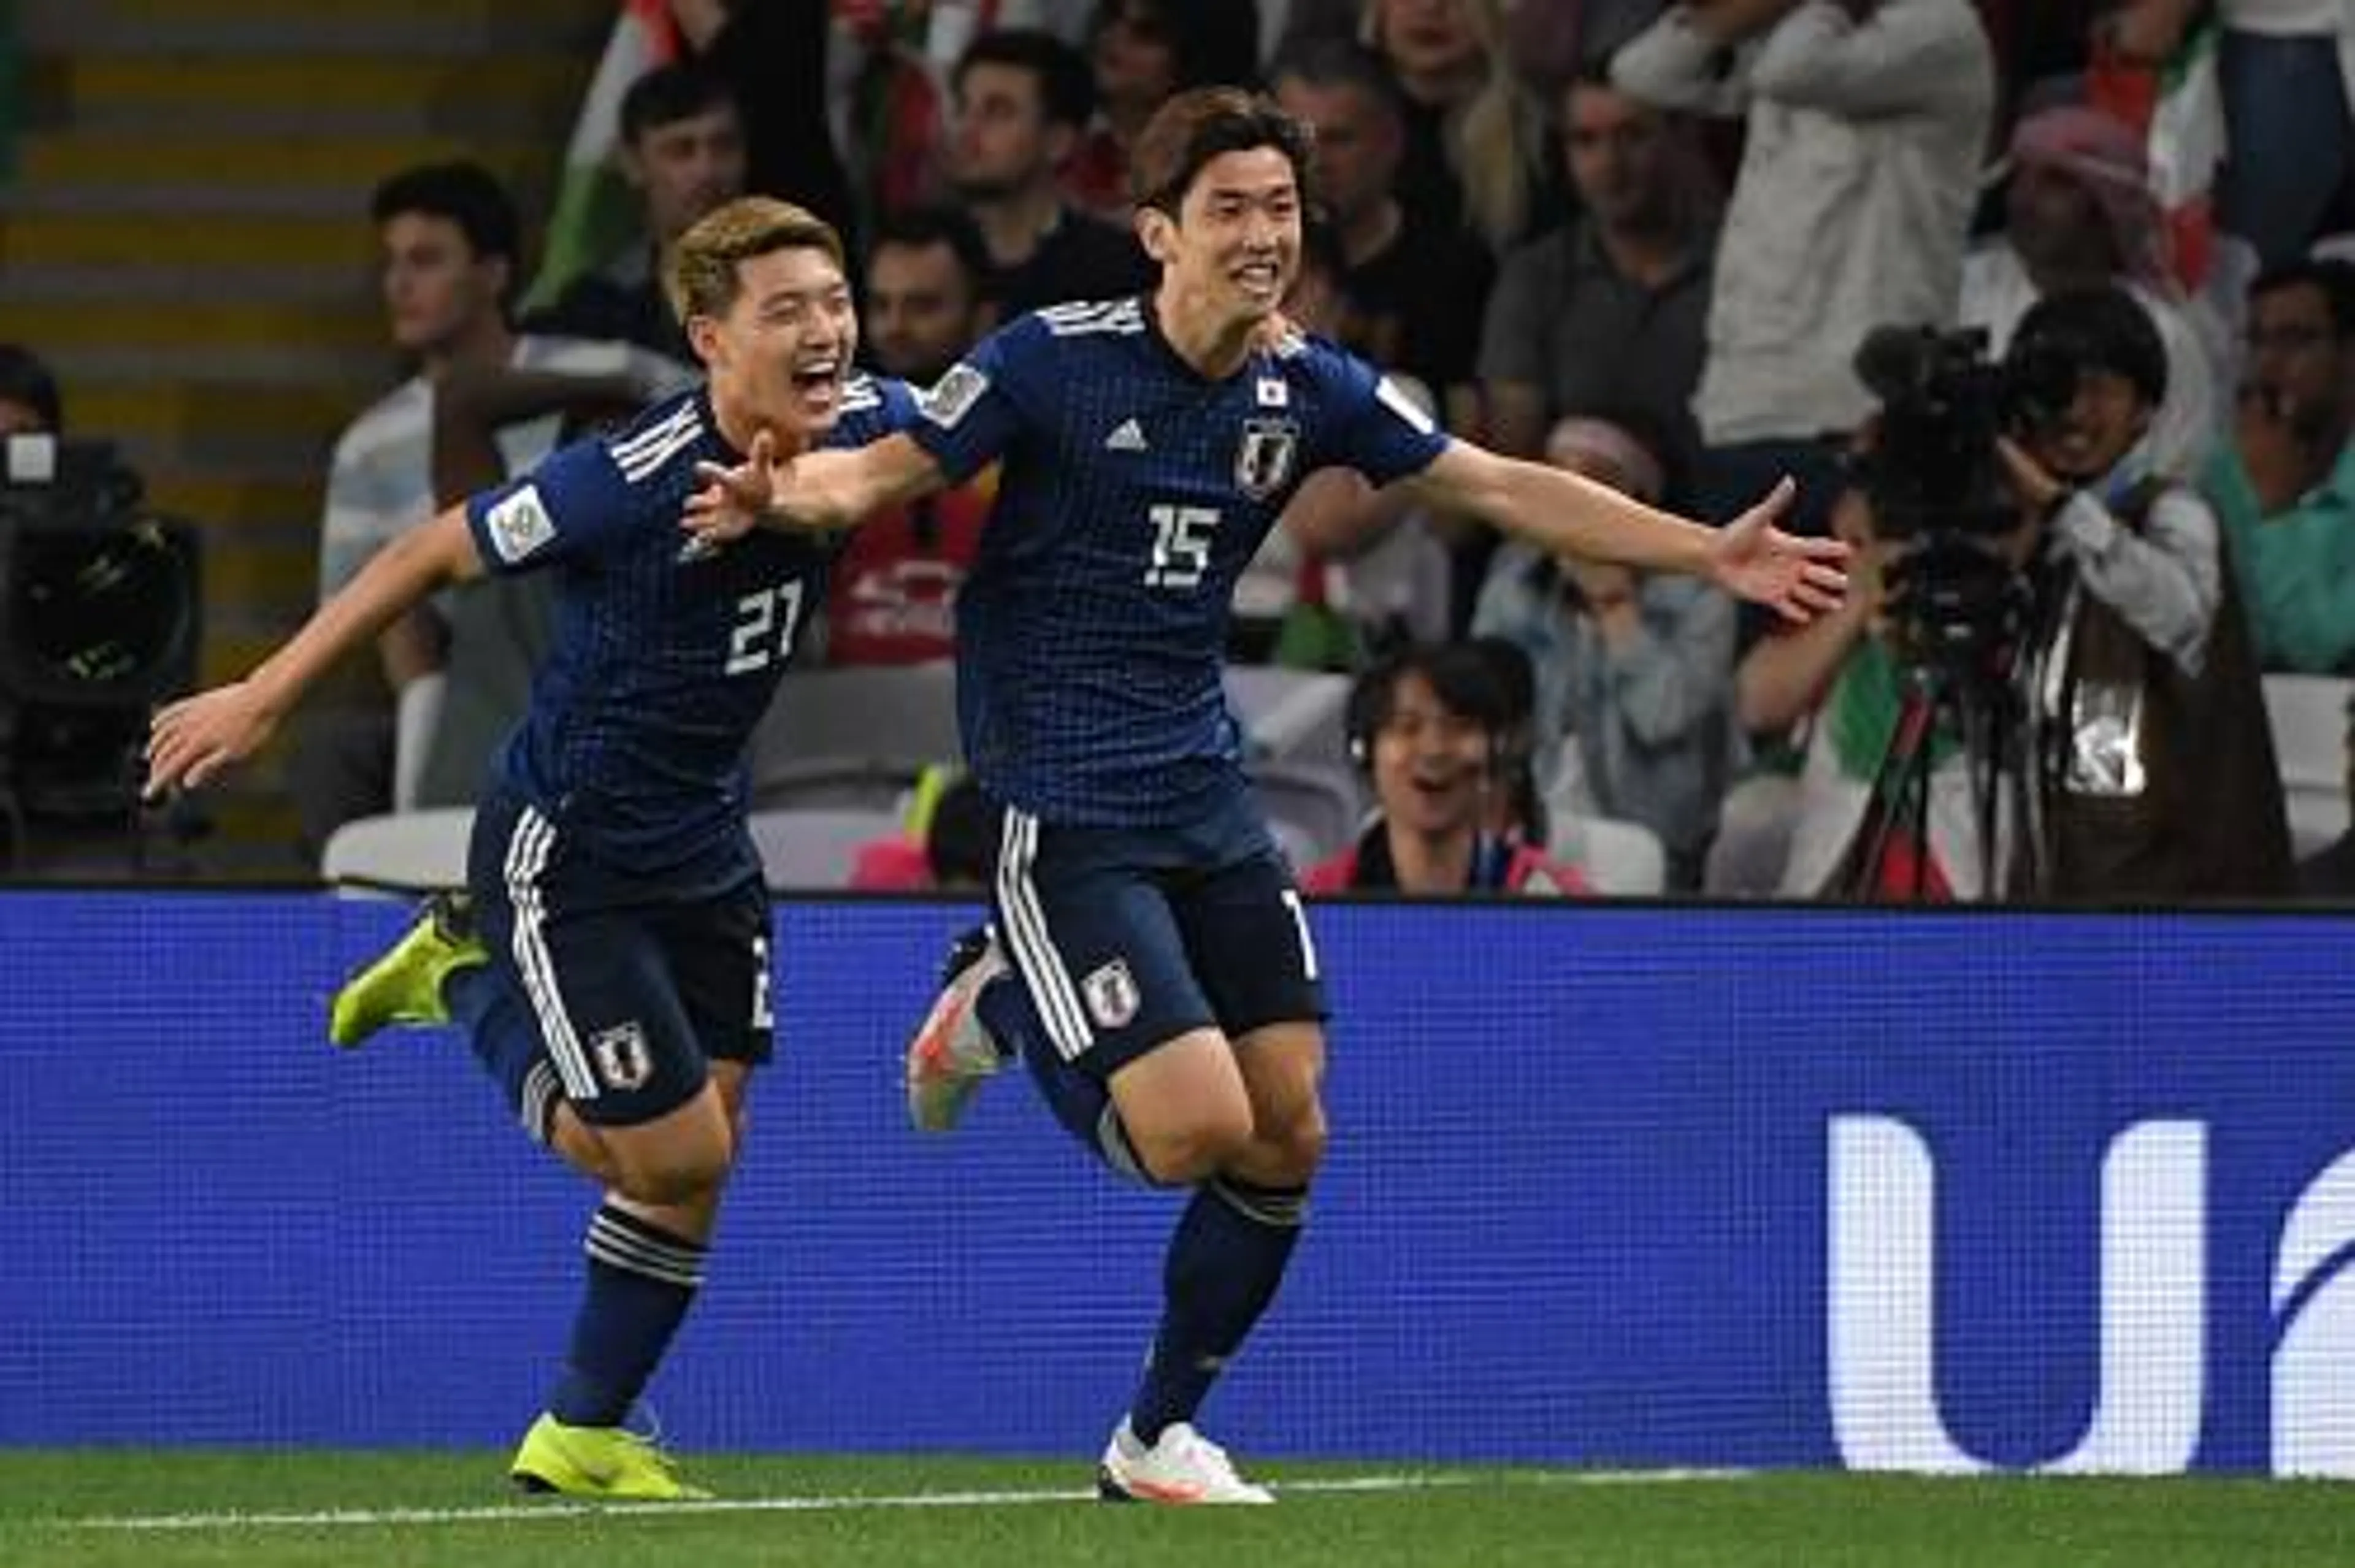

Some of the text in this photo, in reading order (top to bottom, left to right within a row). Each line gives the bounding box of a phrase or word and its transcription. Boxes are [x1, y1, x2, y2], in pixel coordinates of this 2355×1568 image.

[1143, 505, 1220, 587] 15
[724, 579, 802, 675] 21
[1827, 1115, 2355, 1480] U
